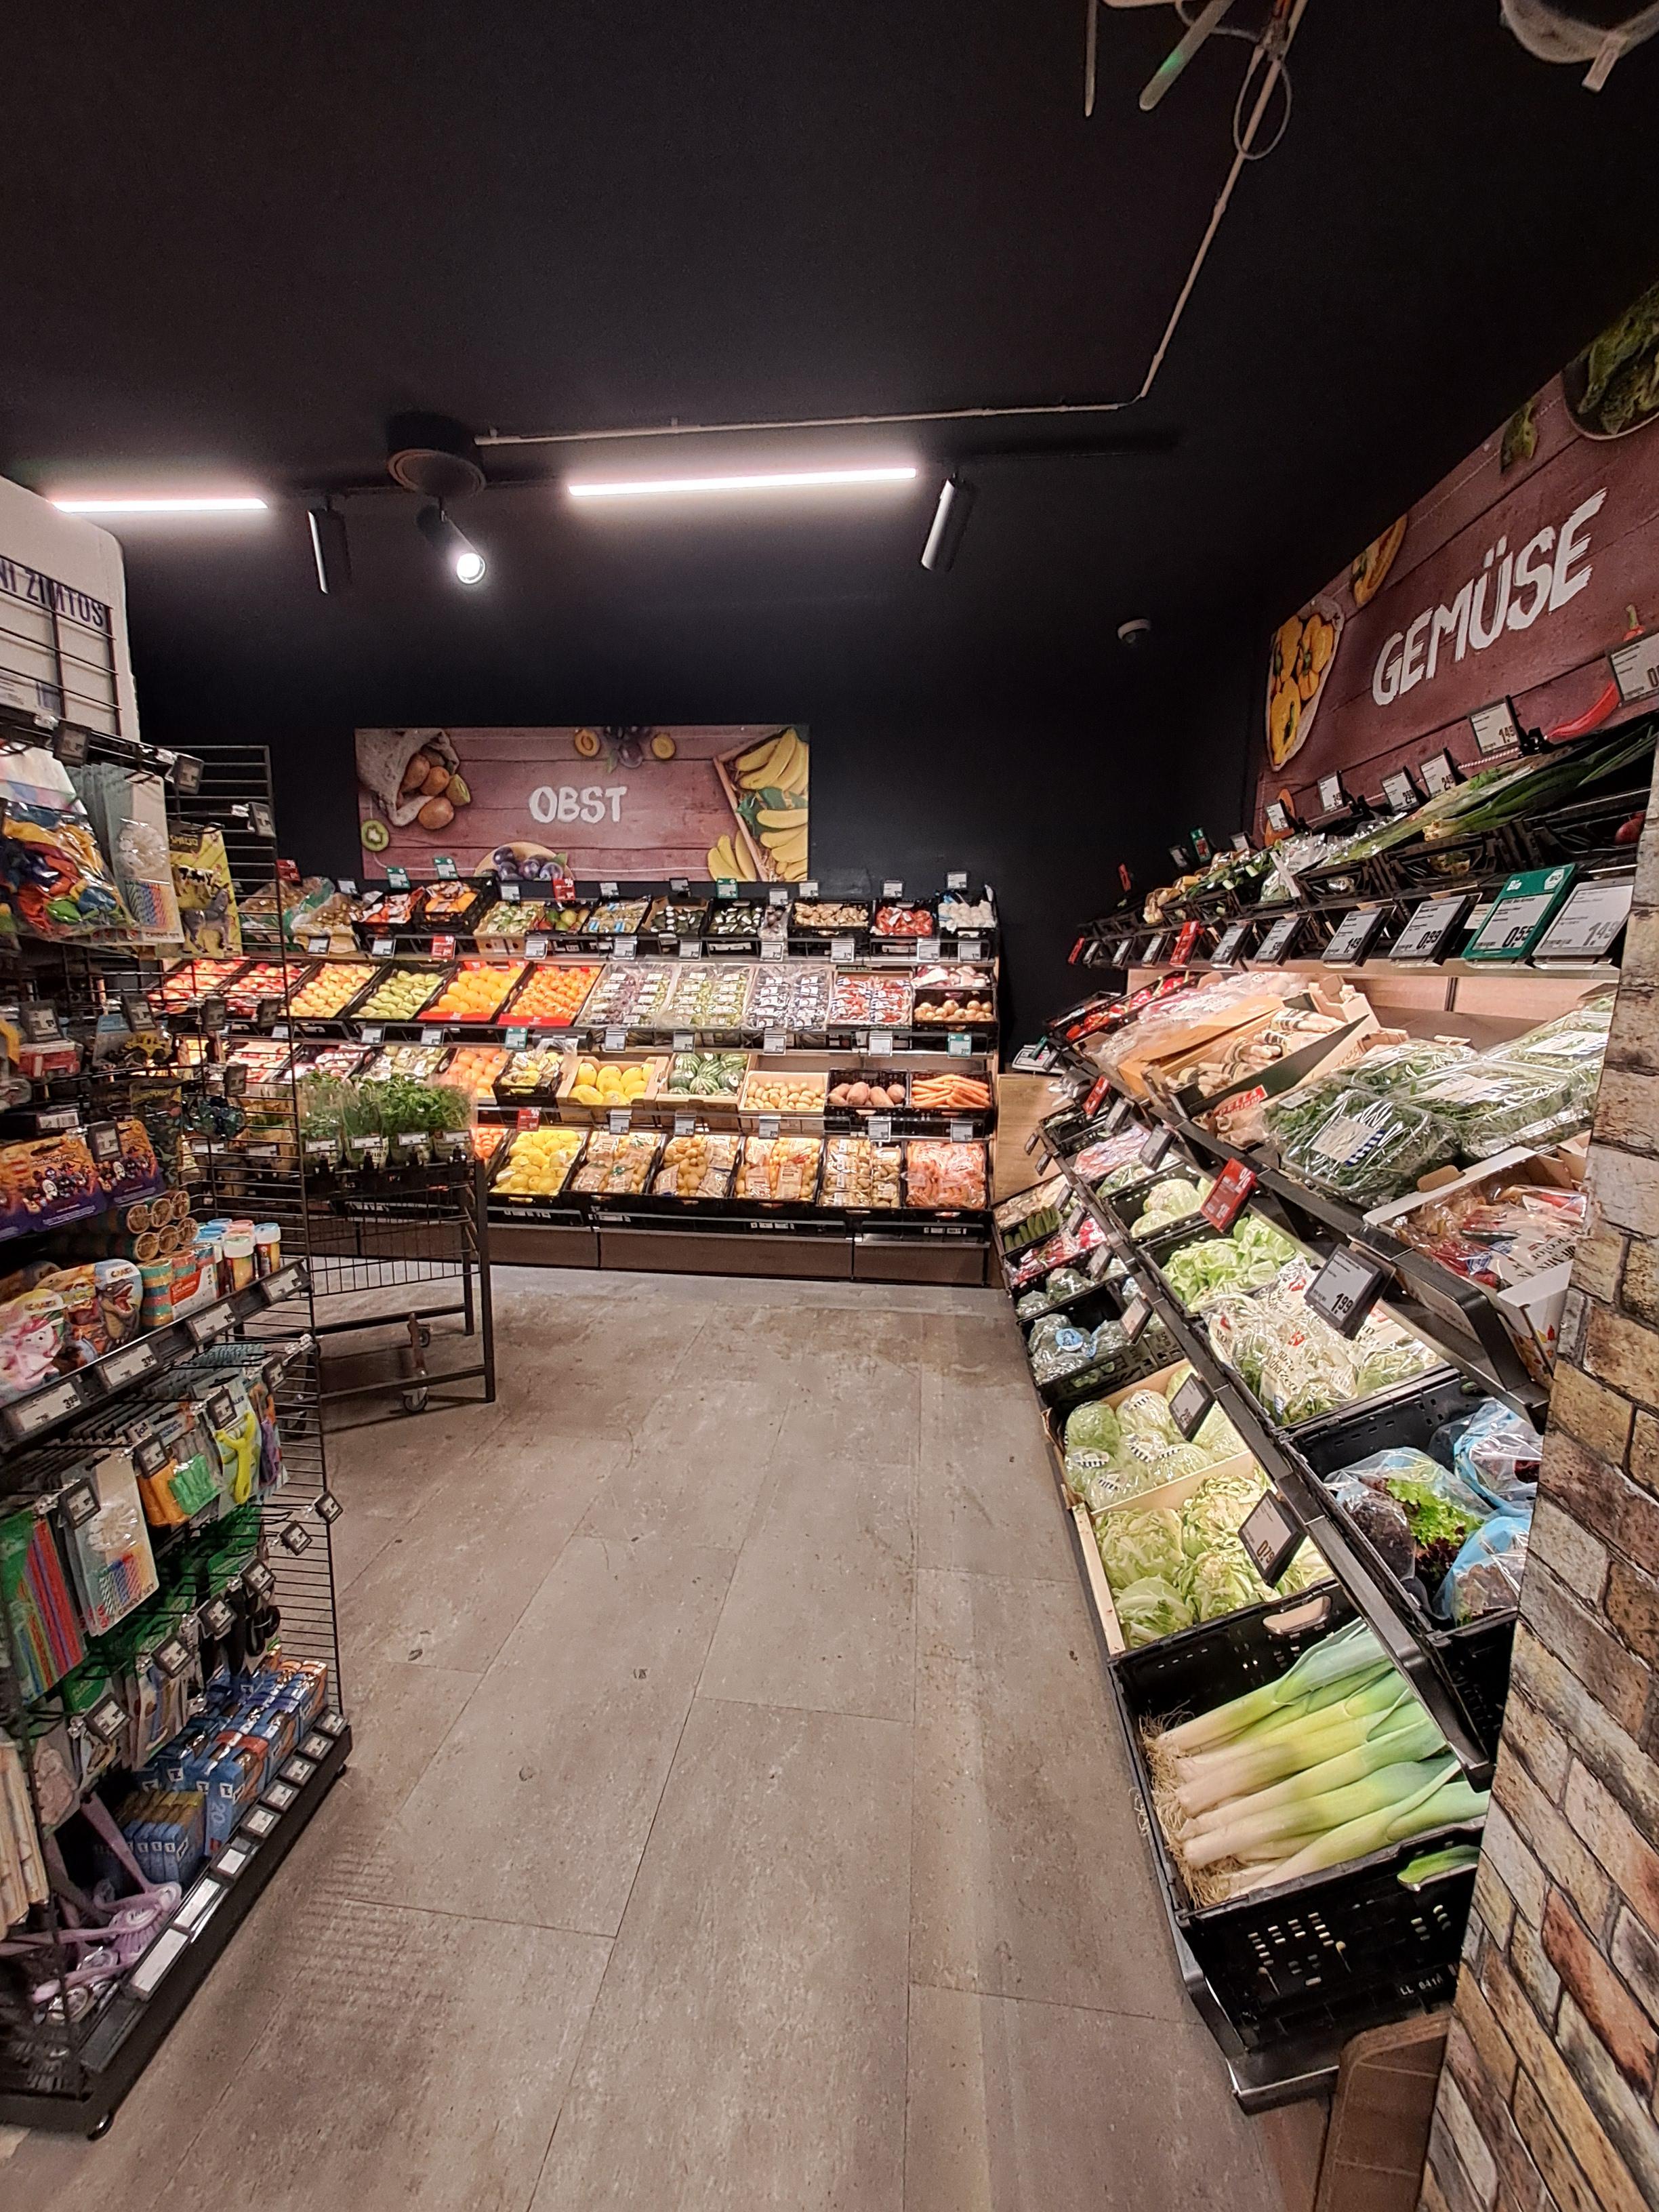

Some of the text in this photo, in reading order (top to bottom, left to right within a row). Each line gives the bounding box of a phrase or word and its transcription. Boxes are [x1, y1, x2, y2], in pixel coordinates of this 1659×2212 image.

[1372, 487, 1607, 705] GEMÜSE
[529, 785, 628, 824] OBST
[1507, 879, 1522, 891] Bio
[1416, 930, 1442, 949] 0.99
[1502, 925, 1534, 947] 0.55
[1583, 921, 1621, 946] 1.49
[1331, 1293, 1353, 1314] 1.99
[1256, 1540, 1275, 1563] 0.79
